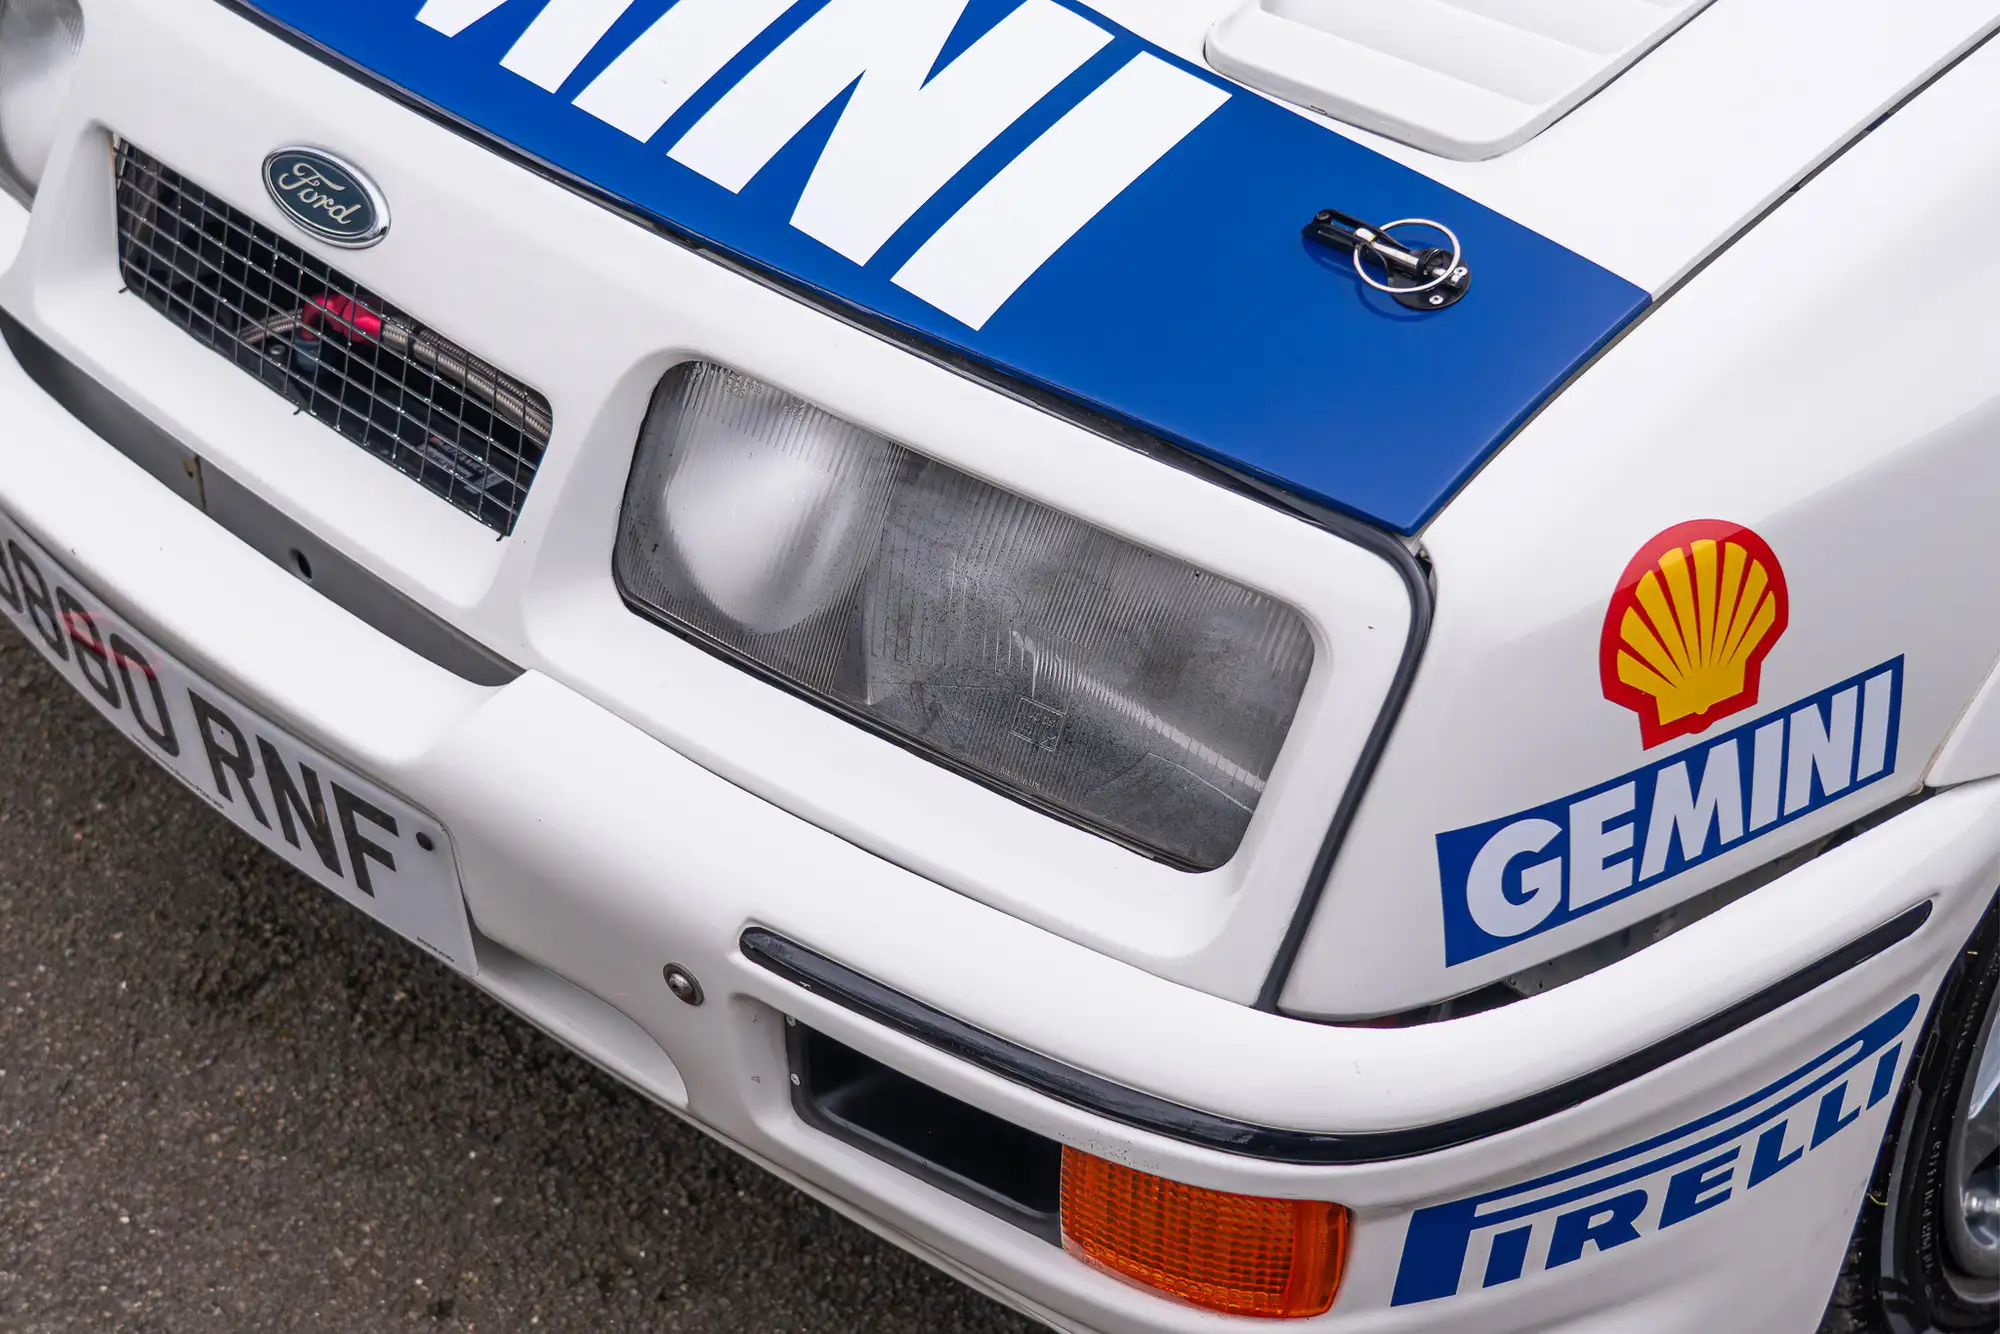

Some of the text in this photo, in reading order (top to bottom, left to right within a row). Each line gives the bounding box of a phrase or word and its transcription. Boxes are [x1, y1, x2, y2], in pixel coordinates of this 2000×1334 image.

[278, 162, 361, 225] Ford
[415, 0, 1233, 332] INI
[187, 688, 398, 898] RNF
[1465, 668, 1893, 939] GEMINI
[1391, 993, 1921, 1306] PIRELLI
